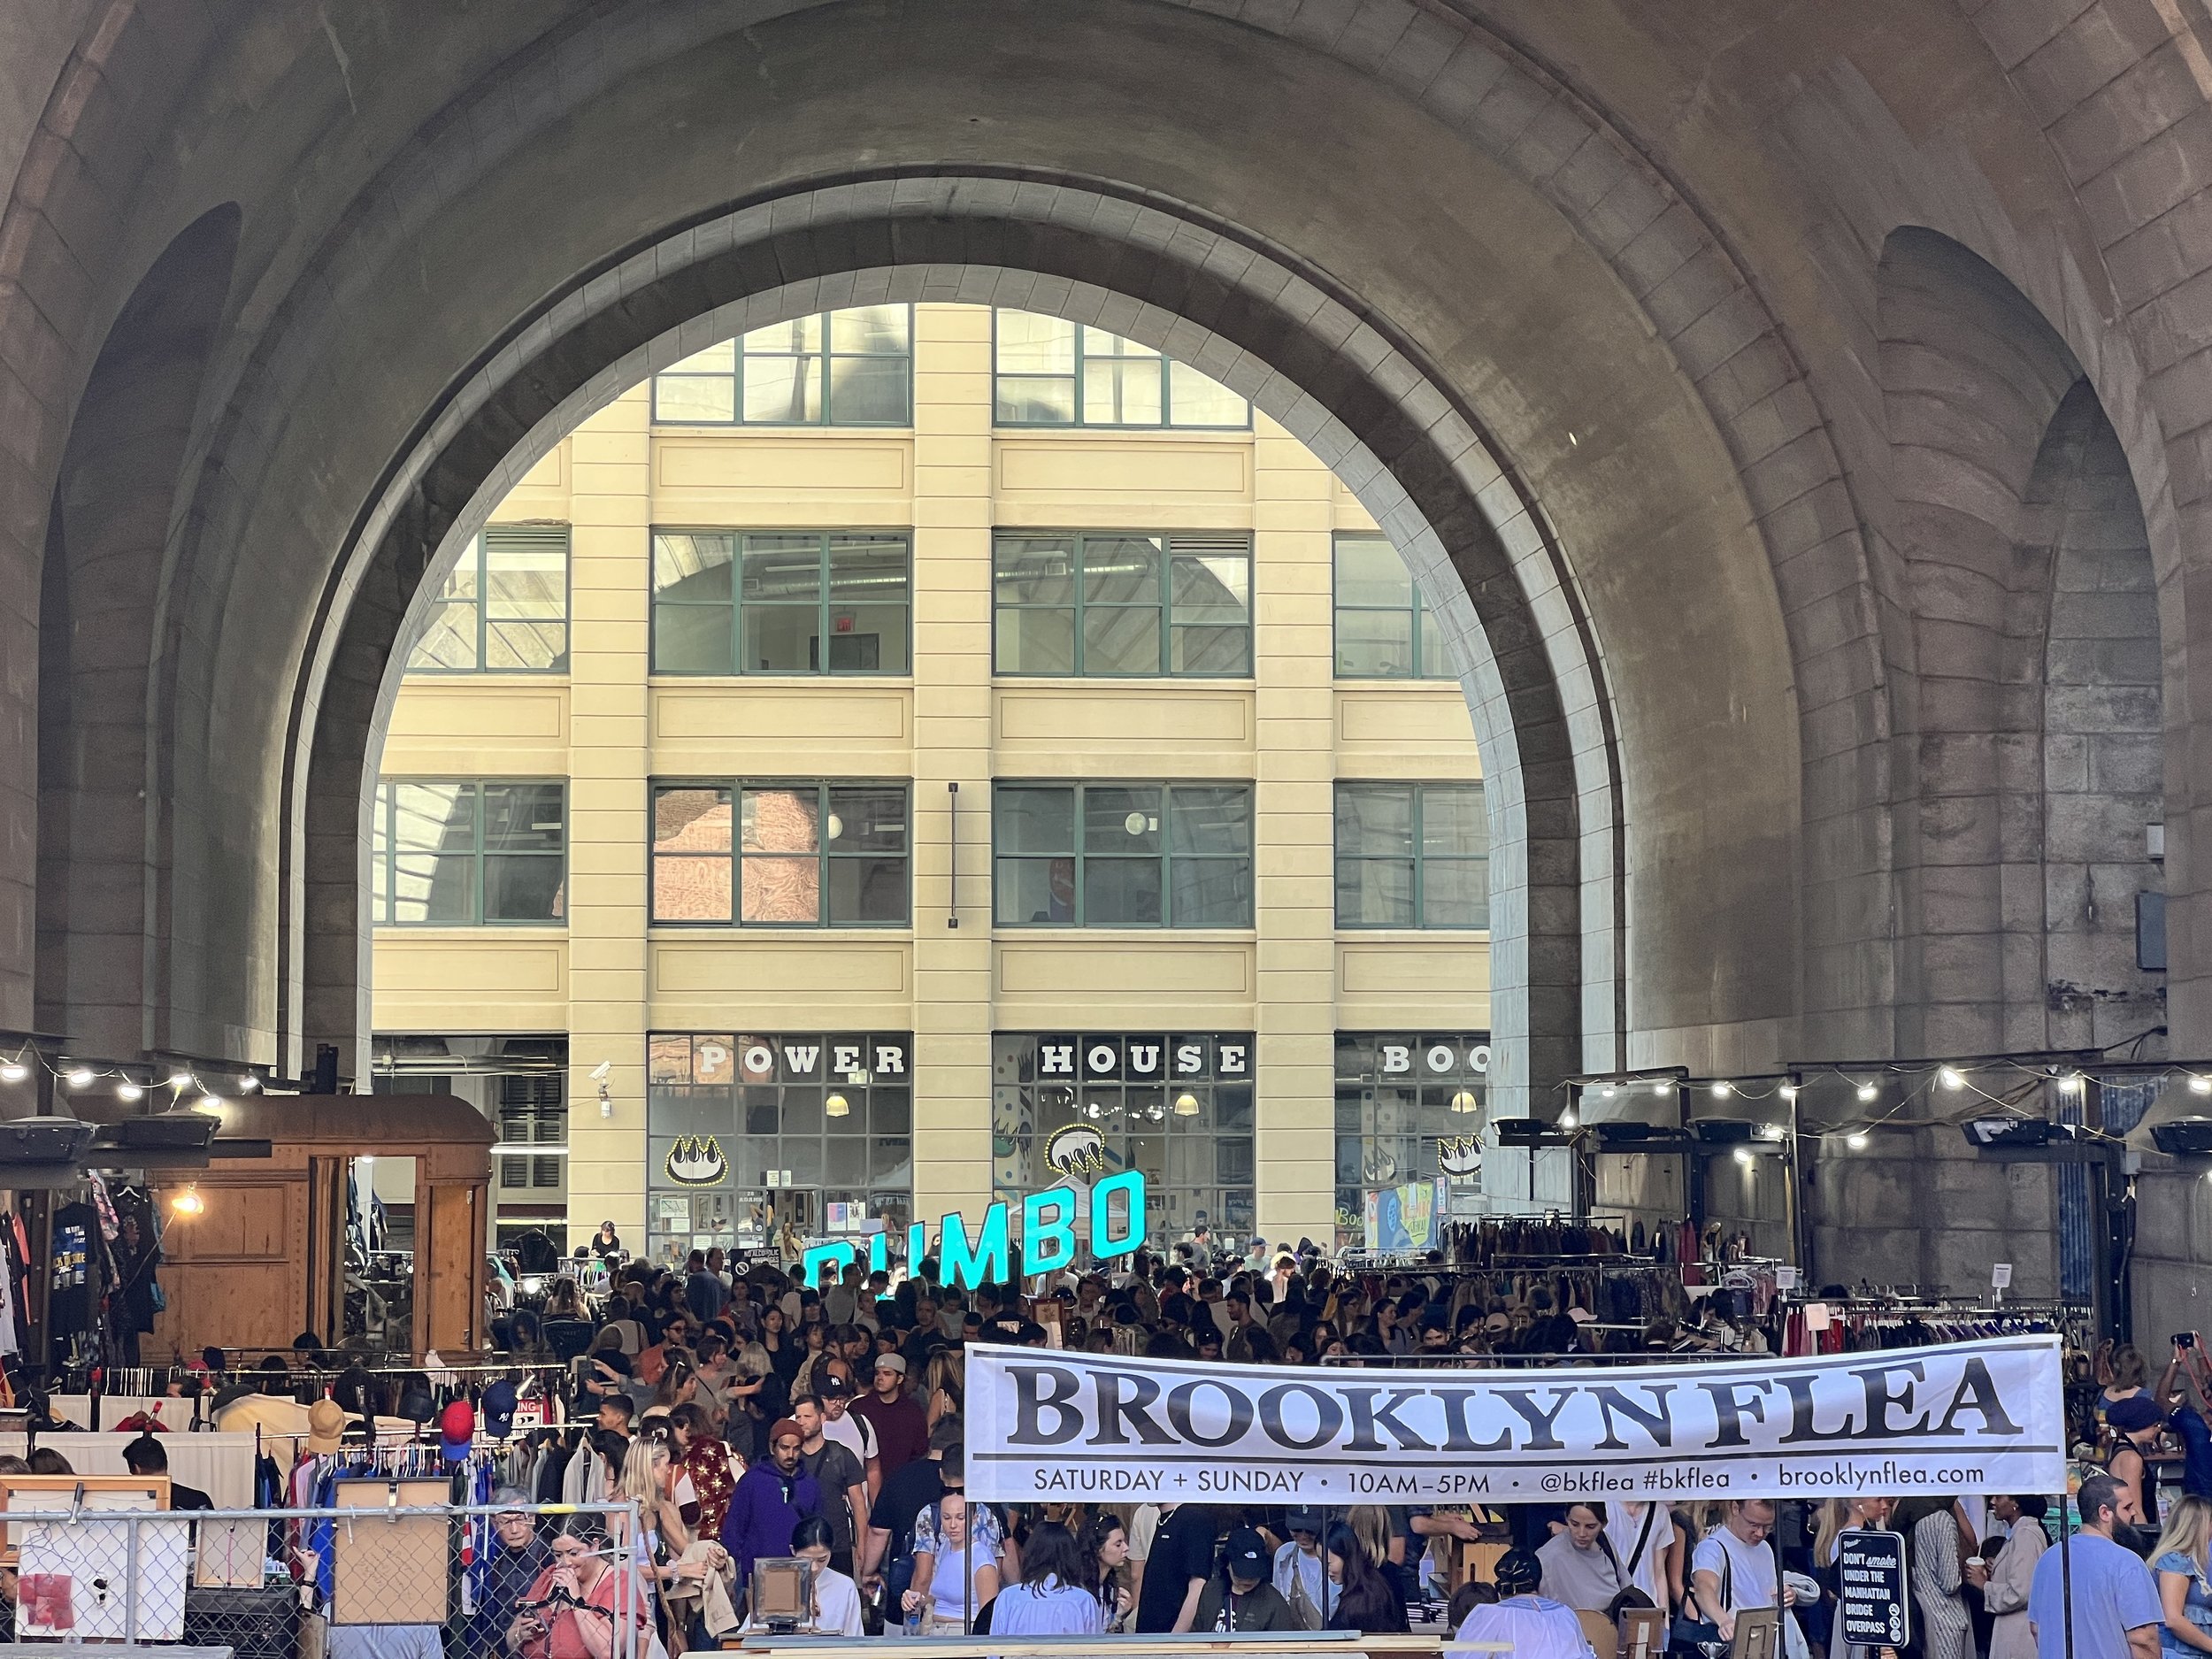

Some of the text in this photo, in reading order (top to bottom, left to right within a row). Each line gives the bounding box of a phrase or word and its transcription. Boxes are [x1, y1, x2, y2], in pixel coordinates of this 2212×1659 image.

[701, 1046, 904, 1072] POWER
[1041, 1045, 1246, 1072] HOUSE
[1004, 1357, 2024, 1452] BROOKLYN FLEA
[1034, 1468, 1164, 1492] SATURDAY
[1197, 1471, 1304, 1492] SUNDAY
[1540, 1471, 1634, 1493] @bkflea
[1642, 1466, 1730, 1490] #bkflea
[1779, 1461, 1984, 1491] brooklynflea.com
[1843, 1553, 1897, 1567] DON'T smoke
[1844, 1569, 1886, 1583] UNDER THE
[1845, 1586, 1891, 1601] MANHATTAN
[1845, 1602, 1874, 1617] BRIDGE
[1846, 1620, 1886, 1634] OVERPASS
